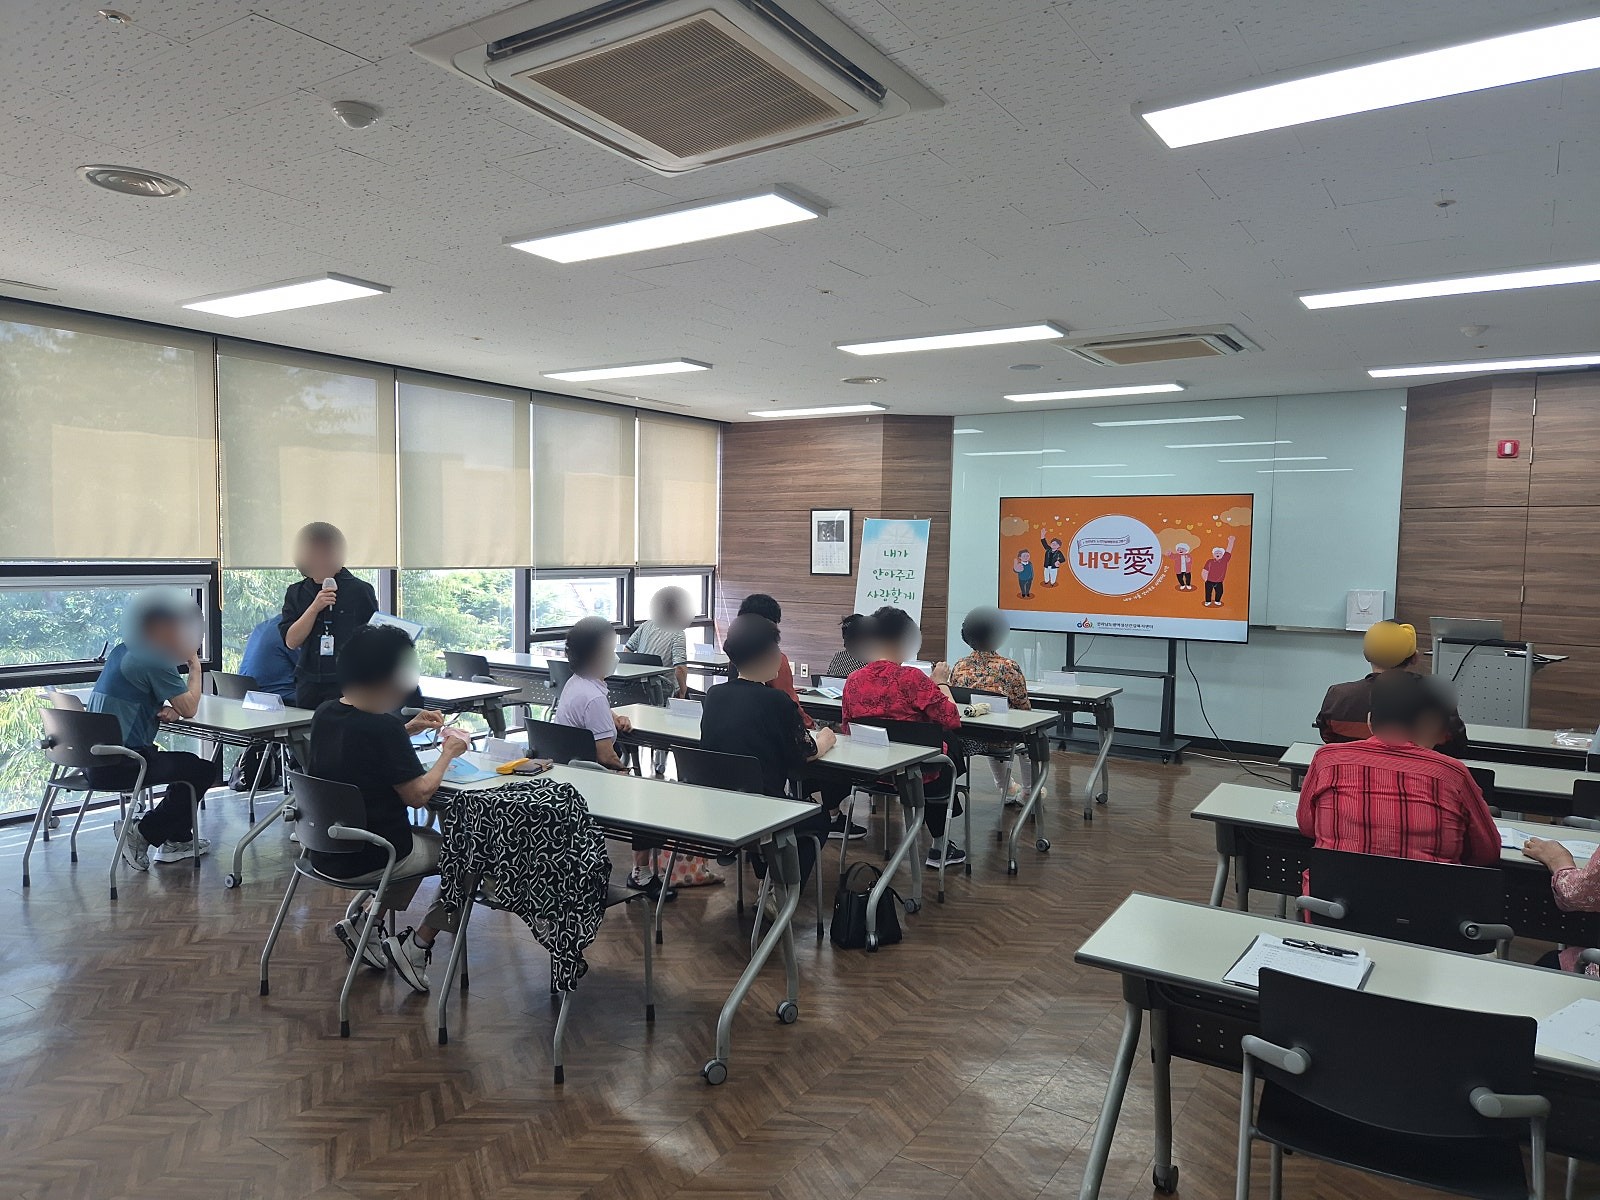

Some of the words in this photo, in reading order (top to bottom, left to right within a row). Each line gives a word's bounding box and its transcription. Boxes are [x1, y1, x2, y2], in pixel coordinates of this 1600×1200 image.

[883, 549, 909, 558] 내가
[872, 568, 915, 581] 안아주고
[867, 587, 915, 604] 사랑할게
